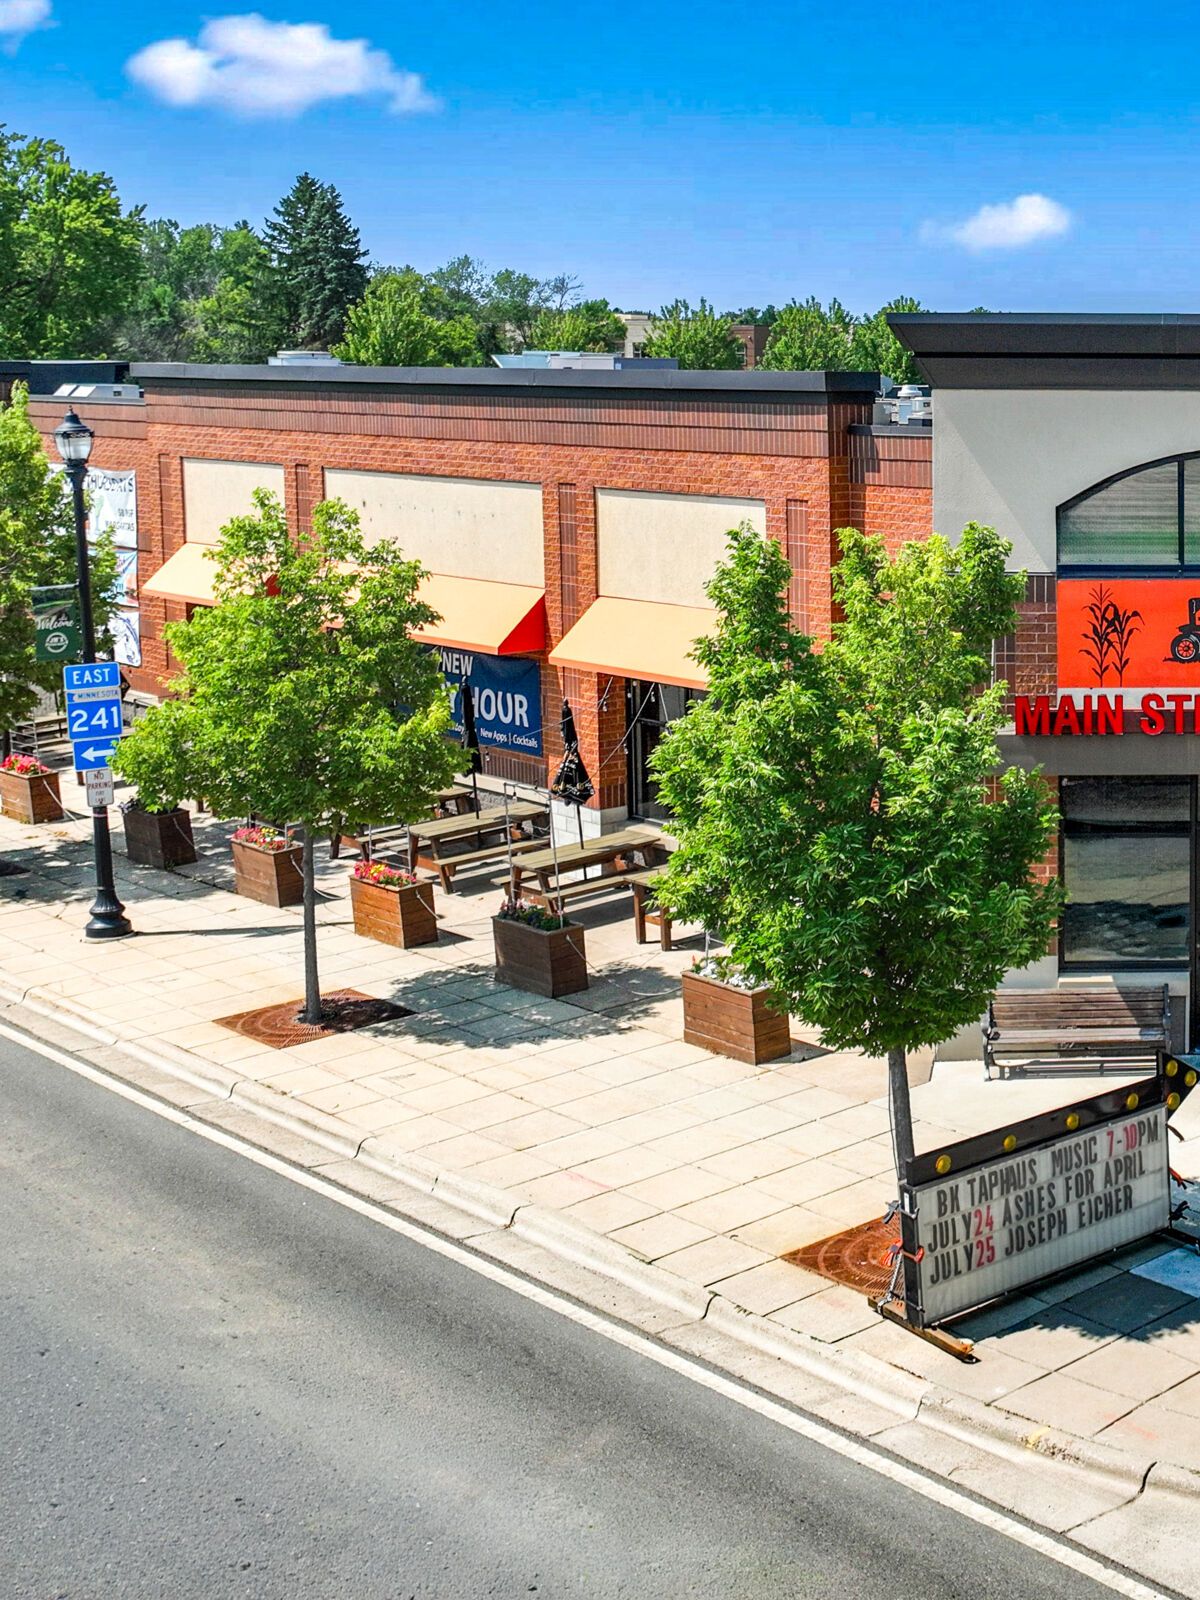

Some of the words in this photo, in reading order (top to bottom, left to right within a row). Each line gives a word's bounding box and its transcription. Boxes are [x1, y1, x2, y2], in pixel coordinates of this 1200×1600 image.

[36, 614, 74, 630] Welcome
[442, 652, 473, 676] NEW
[73, 668, 110, 685] EAST
[77, 690, 118, 699] MINNESOTA
[70, 706, 119, 732] 241
[1015, 694, 1124, 736] MAIN
[480, 728, 492, 739] New
[493, 731, 507, 742] Apps
[513, 734, 538, 748] Cocktails
[87, 781, 111, 790] PARKING
[94, 772, 104, 780] NO
[937, 1184, 960, 1218] BK
[967, 1158, 1037, 1206] TAPHAUS
[1050, 1136, 1098, 1177] MUSIC
[1002, 1182, 1056, 1227] ASHES
[1065, 1168, 1094, 1203] FOR
[1104, 1150, 1146, 1189] APRIL
[1005, 1208, 1067, 1256] JOSEPH
[1078, 1184, 1133, 1229] EICHER
